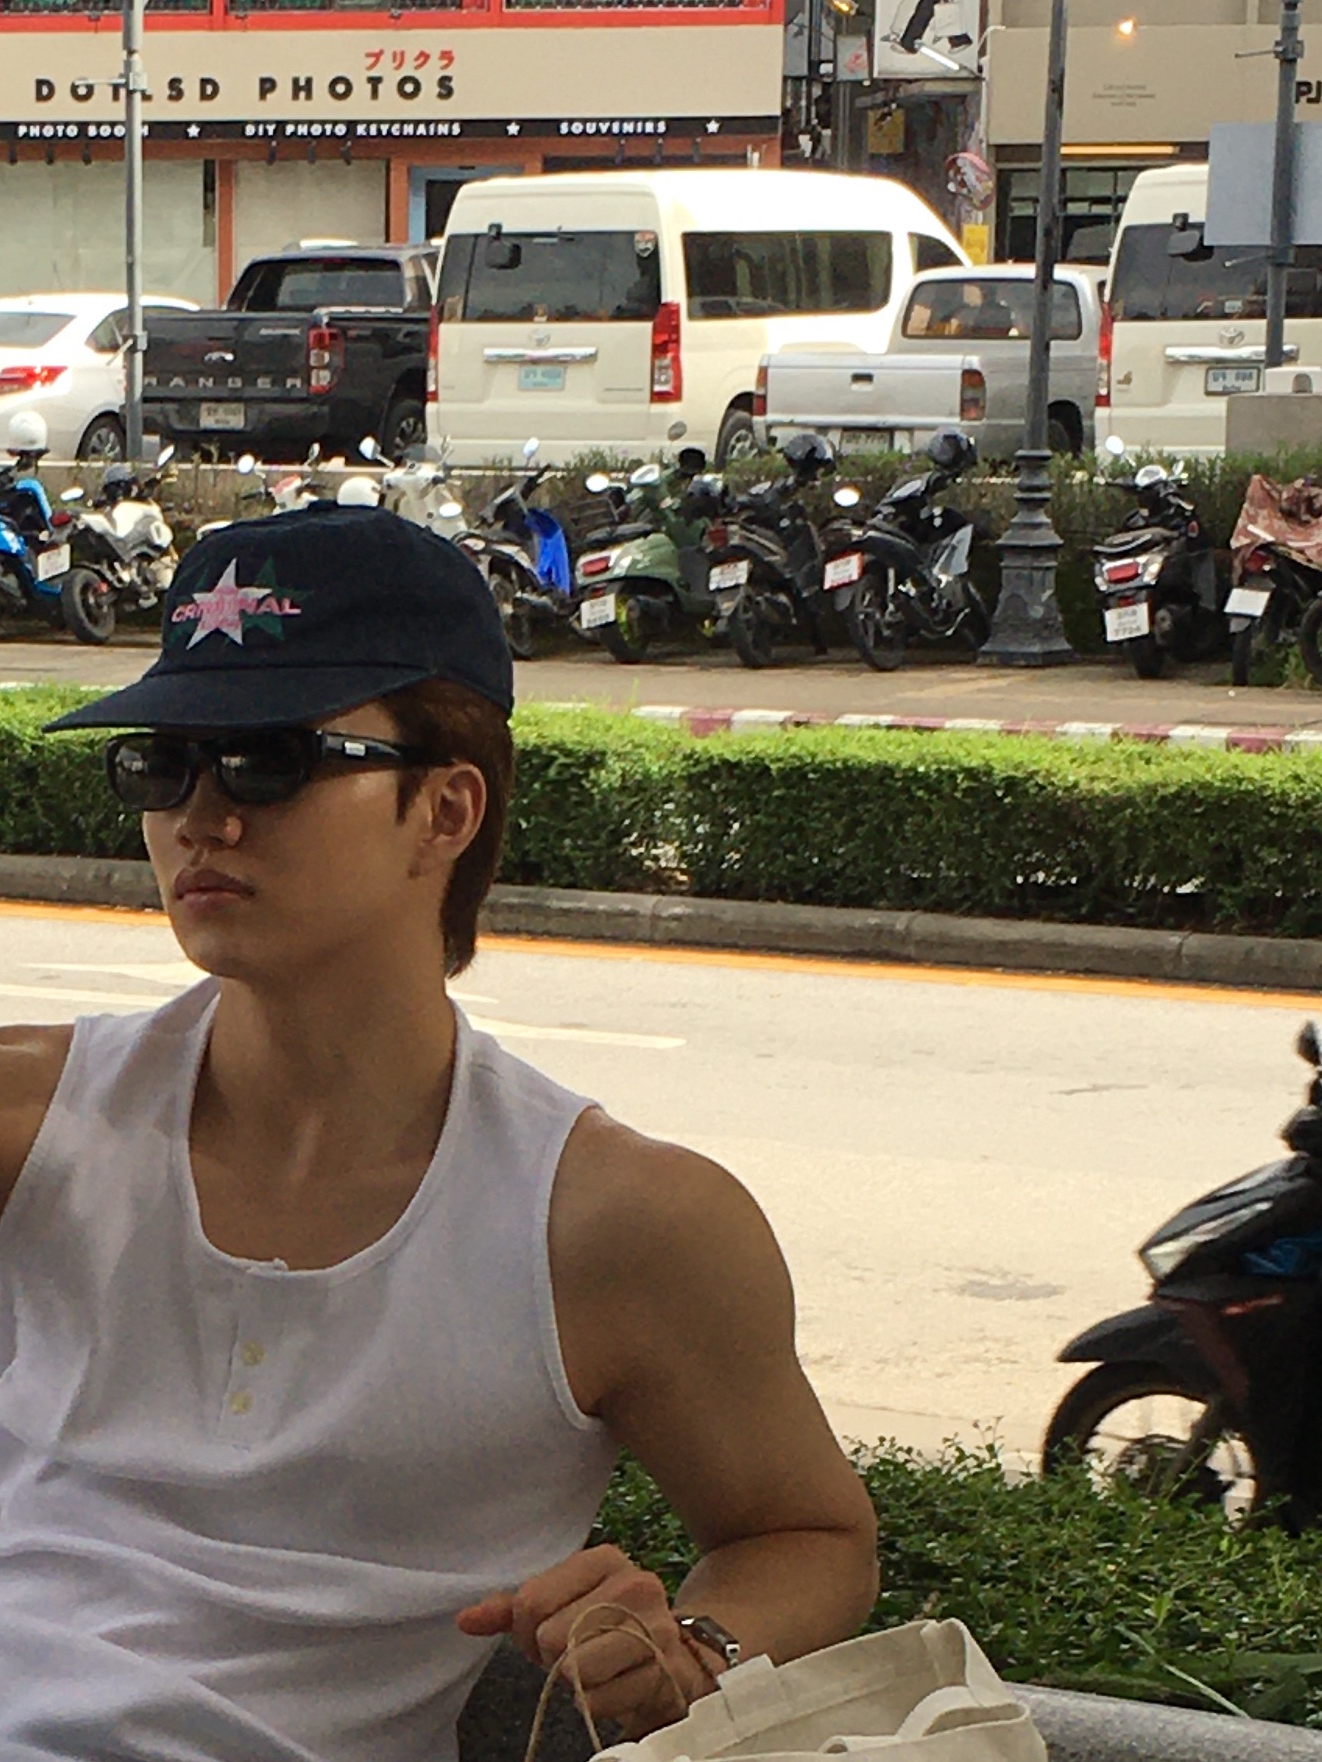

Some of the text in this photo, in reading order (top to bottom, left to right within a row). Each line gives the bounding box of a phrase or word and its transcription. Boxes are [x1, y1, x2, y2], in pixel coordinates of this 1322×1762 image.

[259, 75, 454, 101] PHOTOS
[18, 124, 149, 138] PHOTO BOOH
[244, 122, 461, 137] DIY PHOTO KEYCHAINS
[559, 120, 667, 135] SOUVENIRS
[144, 376, 302, 389] RANGER
